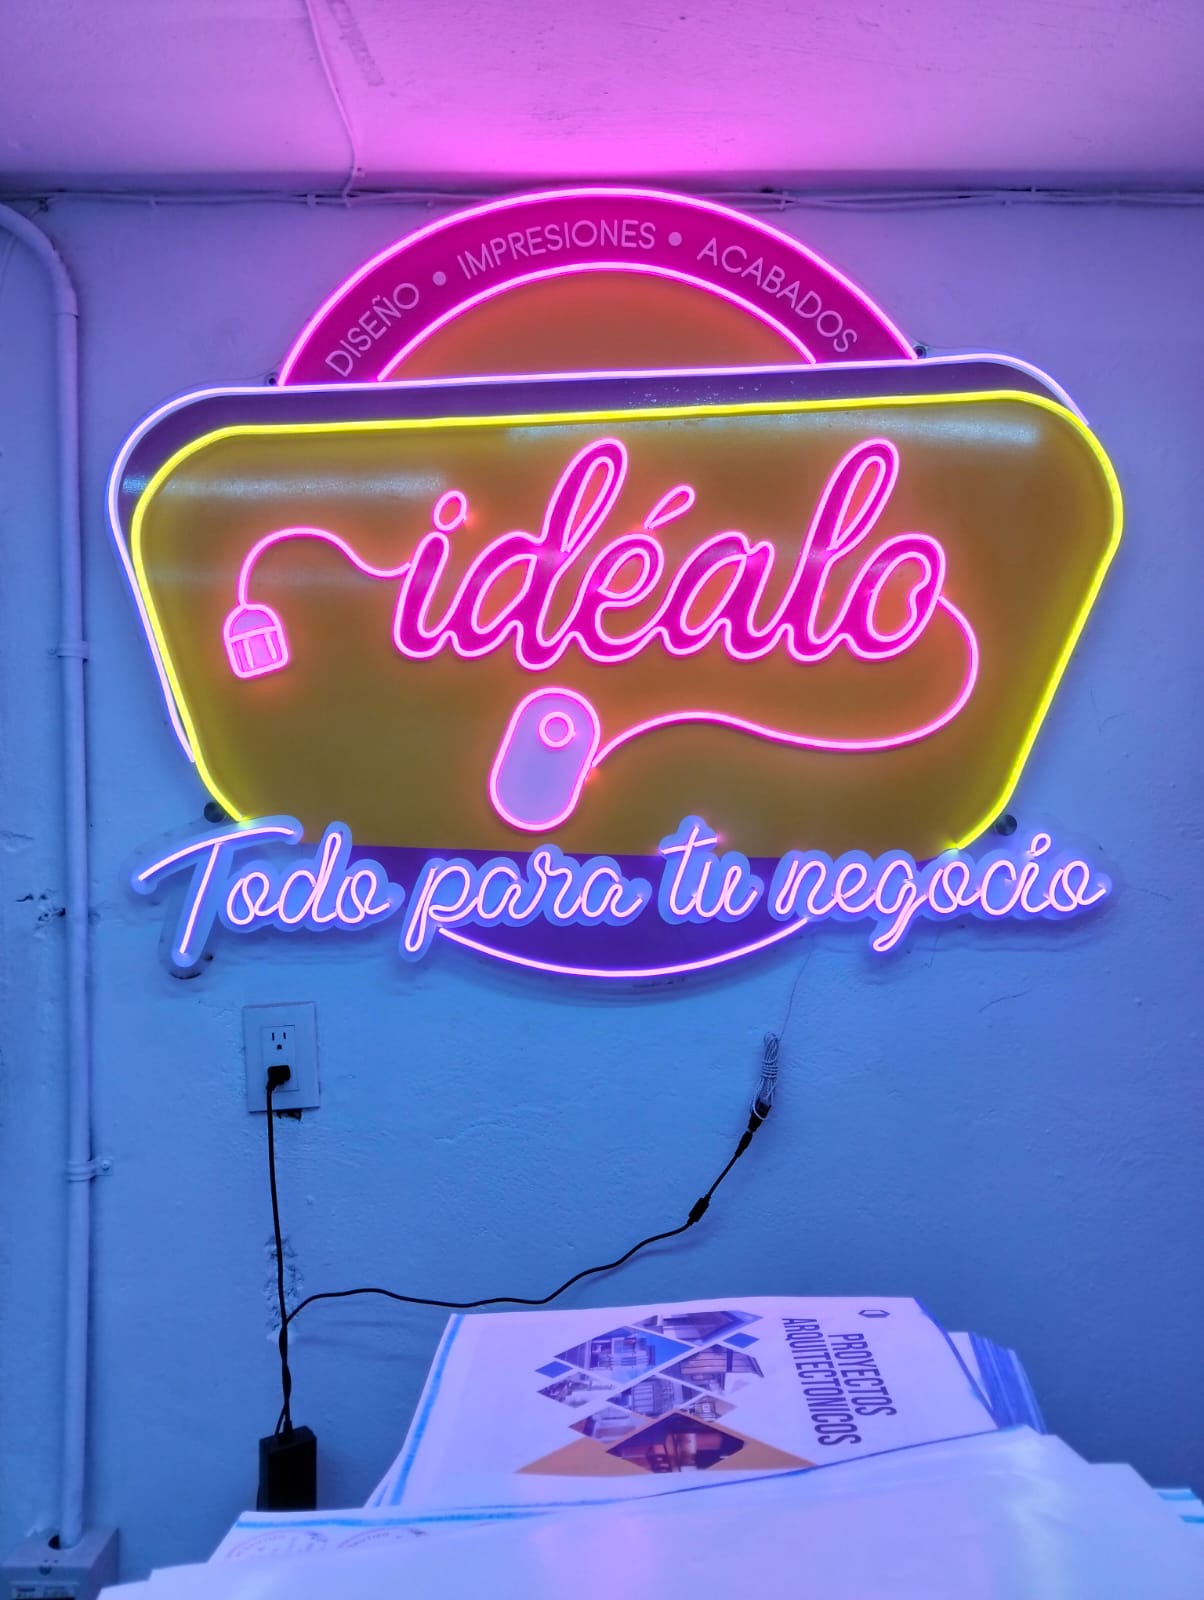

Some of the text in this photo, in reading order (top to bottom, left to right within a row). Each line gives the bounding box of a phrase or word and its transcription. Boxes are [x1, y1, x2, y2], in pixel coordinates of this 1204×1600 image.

[325, 219, 859, 377] DISEÑO IMPRESIONES ACABADOS
[392, 437, 947, 671] idéalo
[135, 825, 1107, 955] Todo para tu negocio
[782, 1318, 862, 1446] ARQUITECTONICOS
[828, 1333, 898, 1416] PROYECTOS
